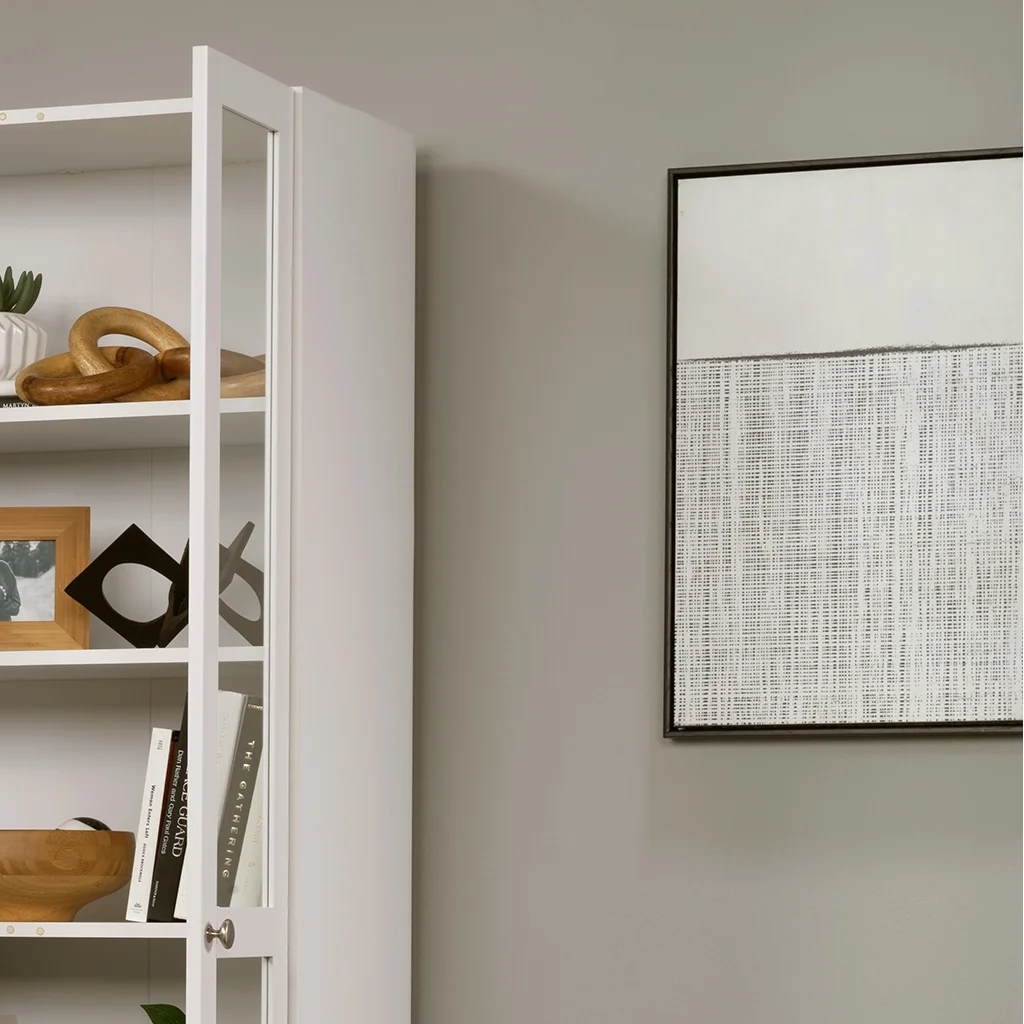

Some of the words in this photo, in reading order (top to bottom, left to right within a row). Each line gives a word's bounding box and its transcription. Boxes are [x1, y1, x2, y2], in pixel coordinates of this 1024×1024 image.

[242, 740, 255, 772] THE
[173, 765, 181, 786] Rather
[166, 803, 174, 820] Gary
[172, 806, 188, 858] GUARD
[222, 780, 247, 878] GATHERING
